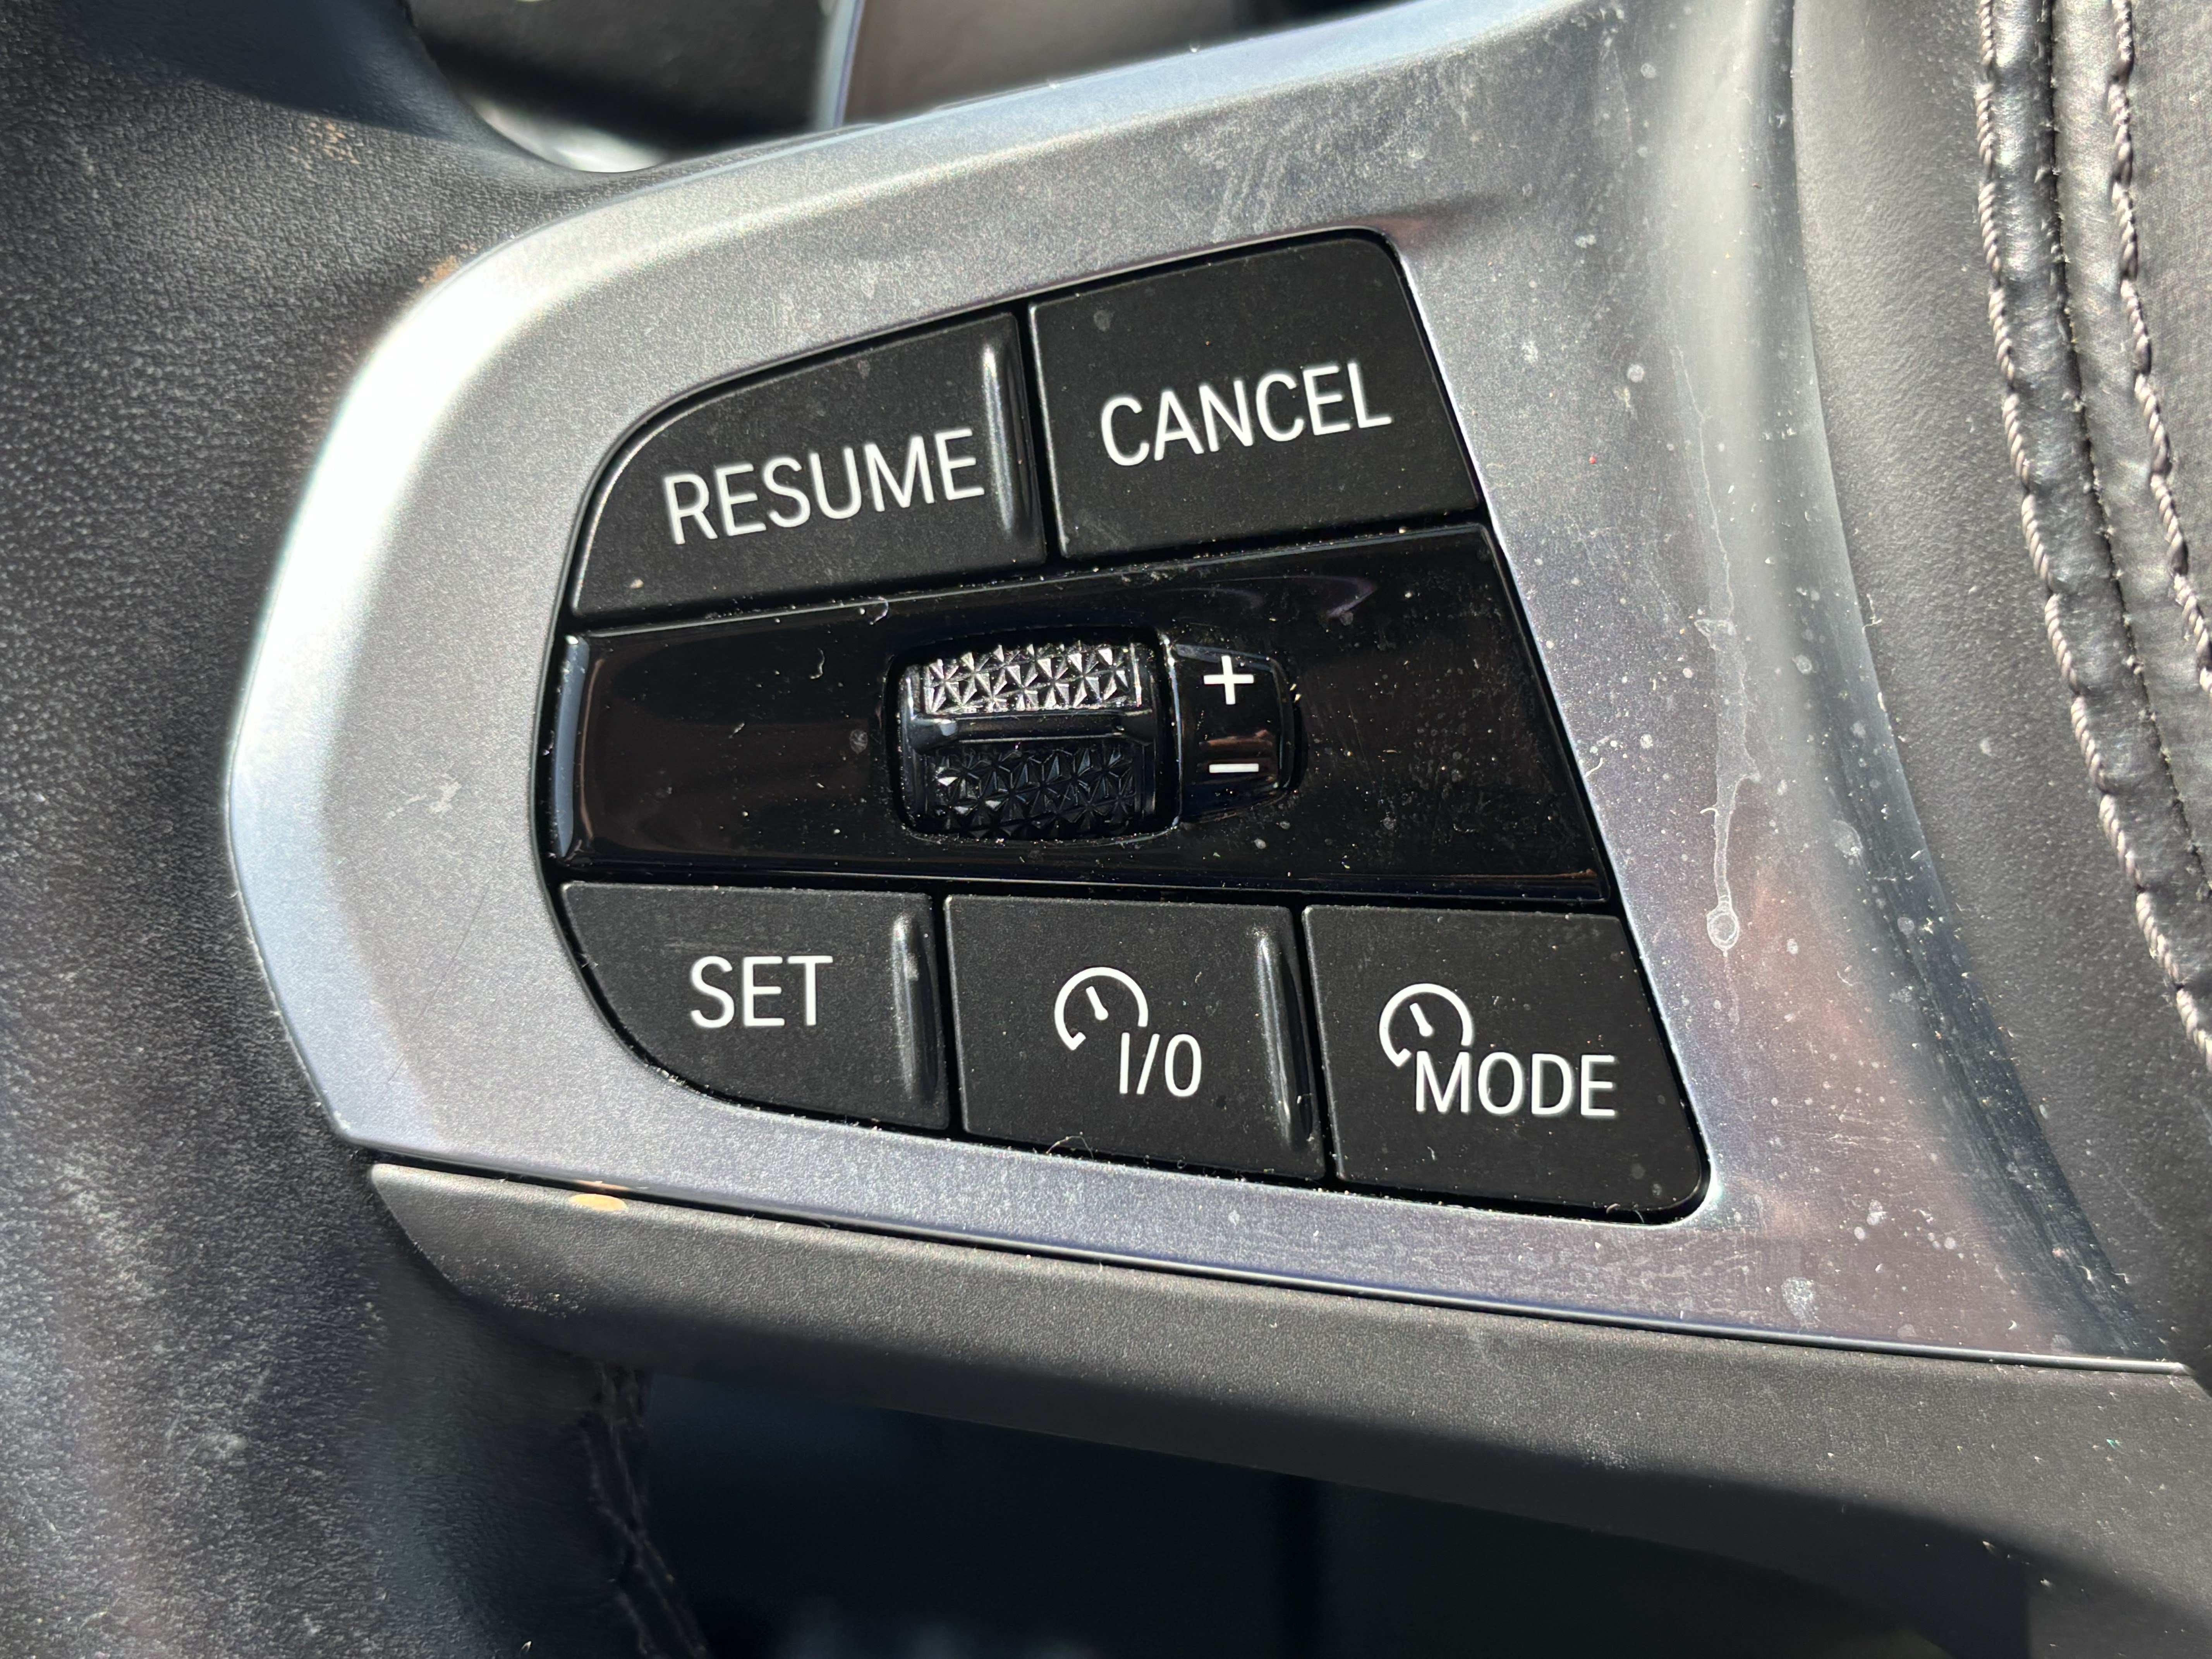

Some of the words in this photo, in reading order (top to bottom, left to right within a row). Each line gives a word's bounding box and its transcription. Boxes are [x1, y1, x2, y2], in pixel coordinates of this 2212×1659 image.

[1101, 362, 1393, 466] CANCEL
[663, 428, 985, 545] RESUME
[690, 955, 834, 1029] SET
[1415, 1050, 1616, 1118] MODE
